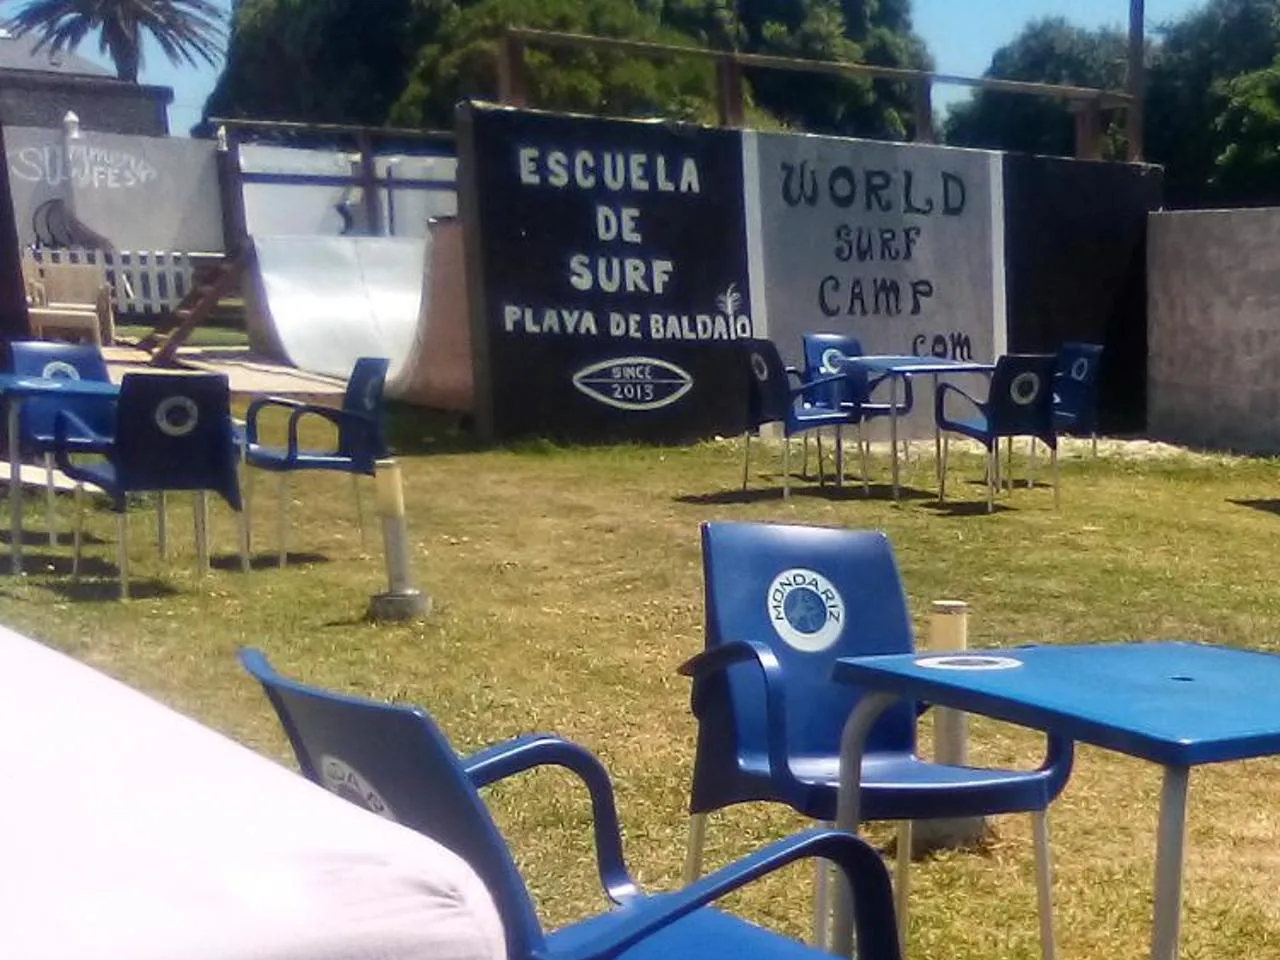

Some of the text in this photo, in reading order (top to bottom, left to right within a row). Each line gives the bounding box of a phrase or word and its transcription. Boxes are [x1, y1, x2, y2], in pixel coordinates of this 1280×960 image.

[519, 147, 700, 193] ESCUELA
[781, 159, 966, 216] WORLD
[596, 205, 642, 244] DE
[834, 223, 921, 262] SURF
[569, 253, 674, 294] SURF
[818, 275, 934, 317] CAMP
[609, 312, 642, 339] DE
[612, 365, 653, 379] SINCE
[773, 573, 840, 624] MONDARIZ
